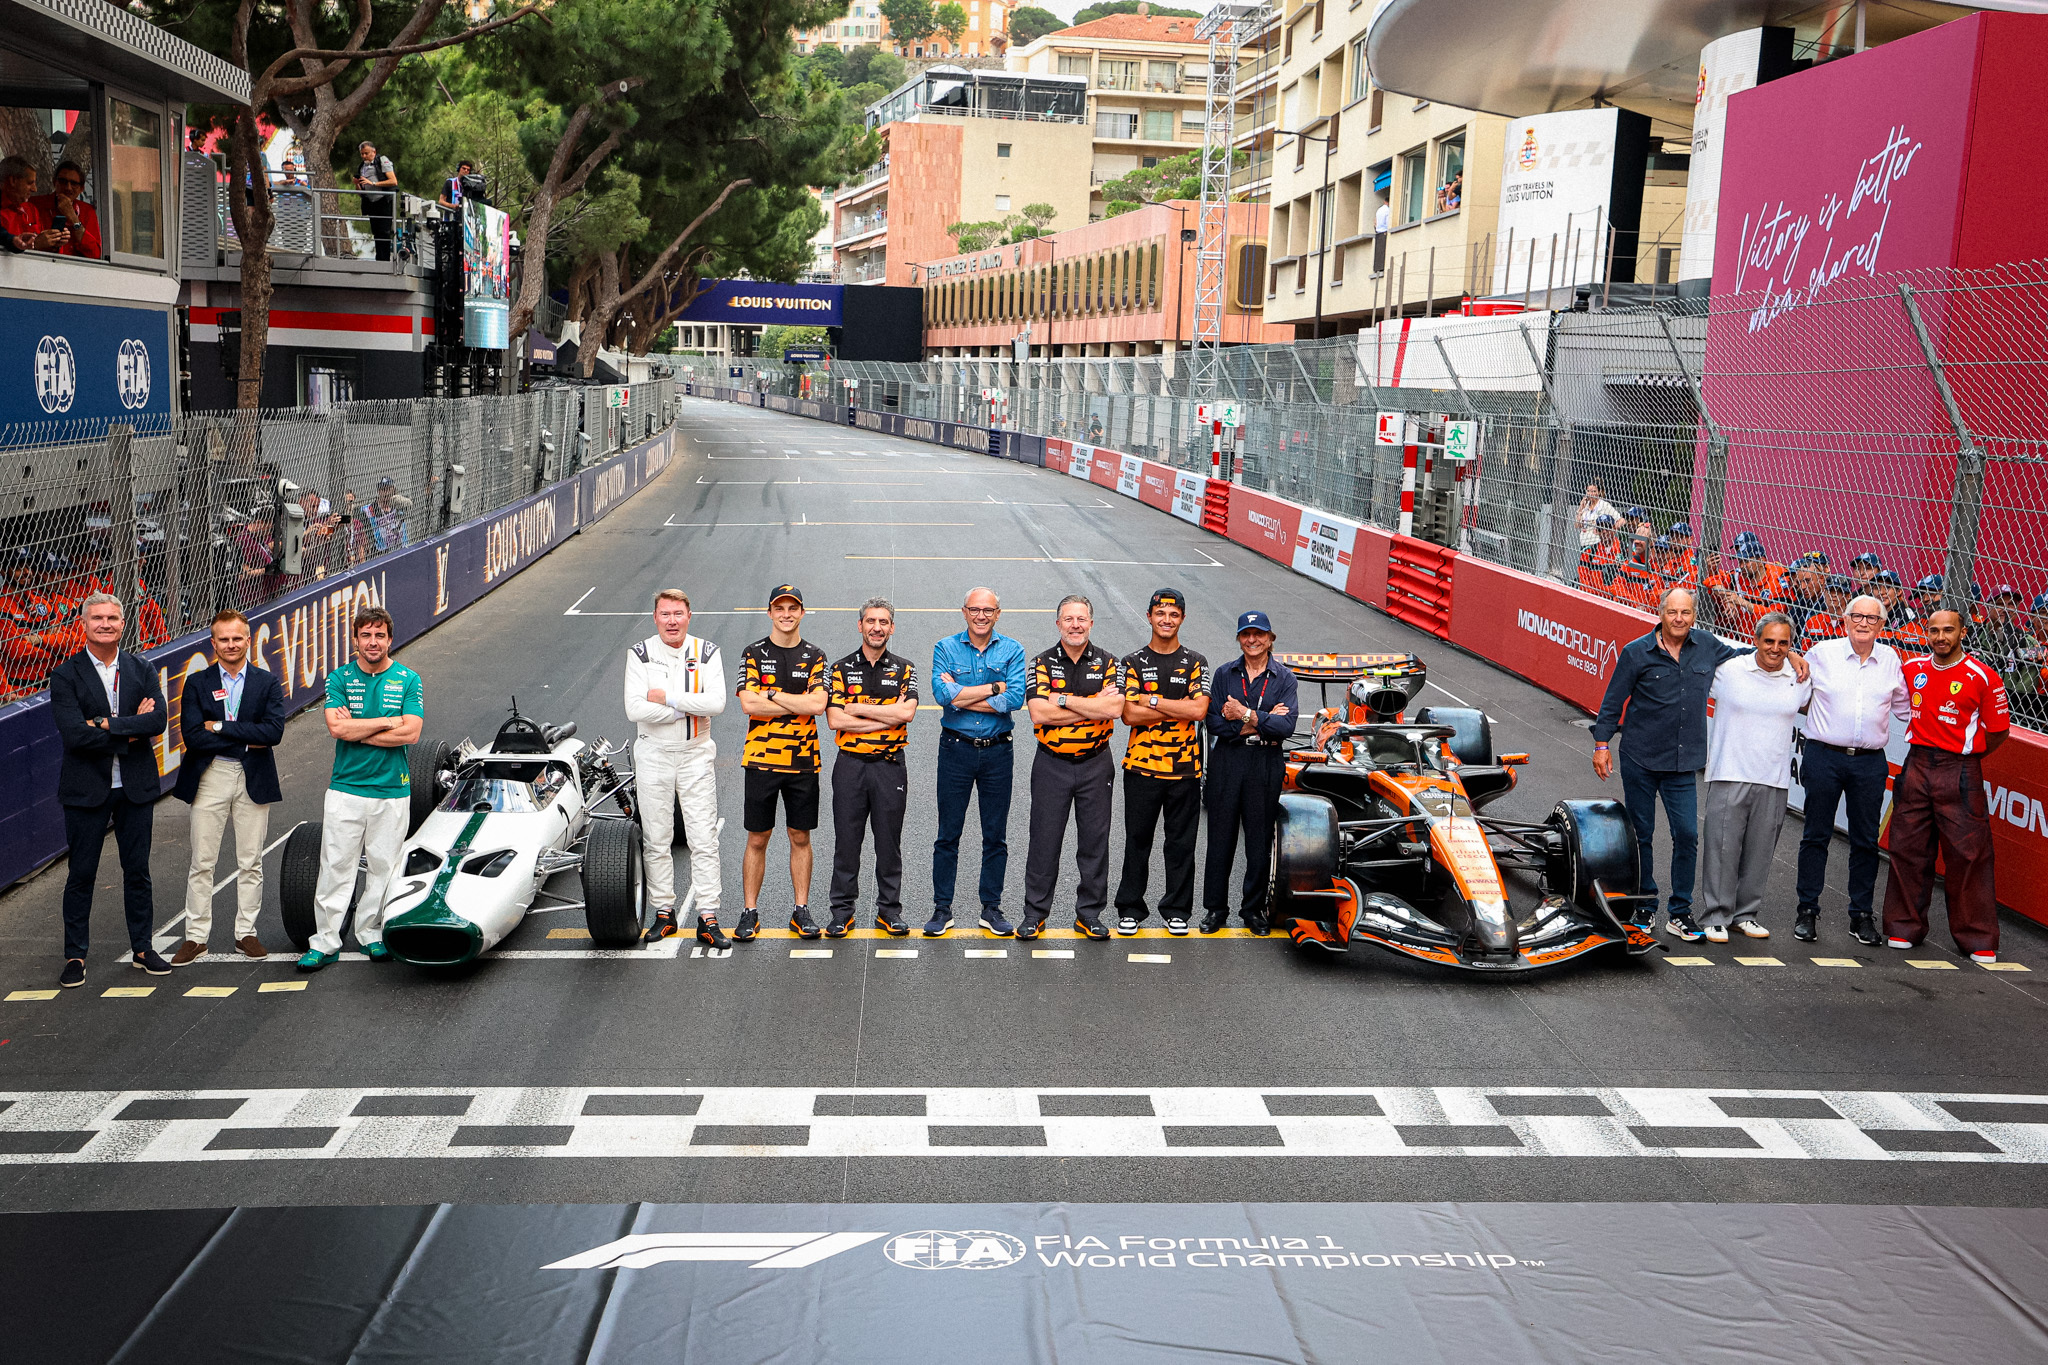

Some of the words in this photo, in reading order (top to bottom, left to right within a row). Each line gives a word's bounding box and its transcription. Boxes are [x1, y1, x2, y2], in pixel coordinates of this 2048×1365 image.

[1523, 181, 1545, 192] TRAVELS
[1546, 180, 1554, 189] IN
[1506, 191, 1520, 204] LOUIS
[1521, 189, 1554, 201] VUITTON
[1735, 200, 1811, 296] Victory
[1819, 192, 1843, 232] is
[1846, 124, 1922, 220] better
[1806, 199, 1892, 308] shared
[732, 295, 773, 309] LOUIS
[775, 297, 832, 311] VUITTON
[953, 426, 969, 447] LOUIS
[969, 427, 991, 452] VUITTON
[484, 513, 519, 584] LOUIS
[518, 493, 556, 560] VUITTON
[1325, 543, 1335, 560] PRIX
[1567, 654, 1583, 670] SINCE
[1584, 660, 1598, 676] 1929
[1554, 805, 1572, 832] ZERO
[1034, 1235, 1111, 1251] FIA
[1118, 1235, 1314, 1250] Formula
[1315, 1235, 1345, 1250] 1
[1036, 1251, 1177, 1268] World
